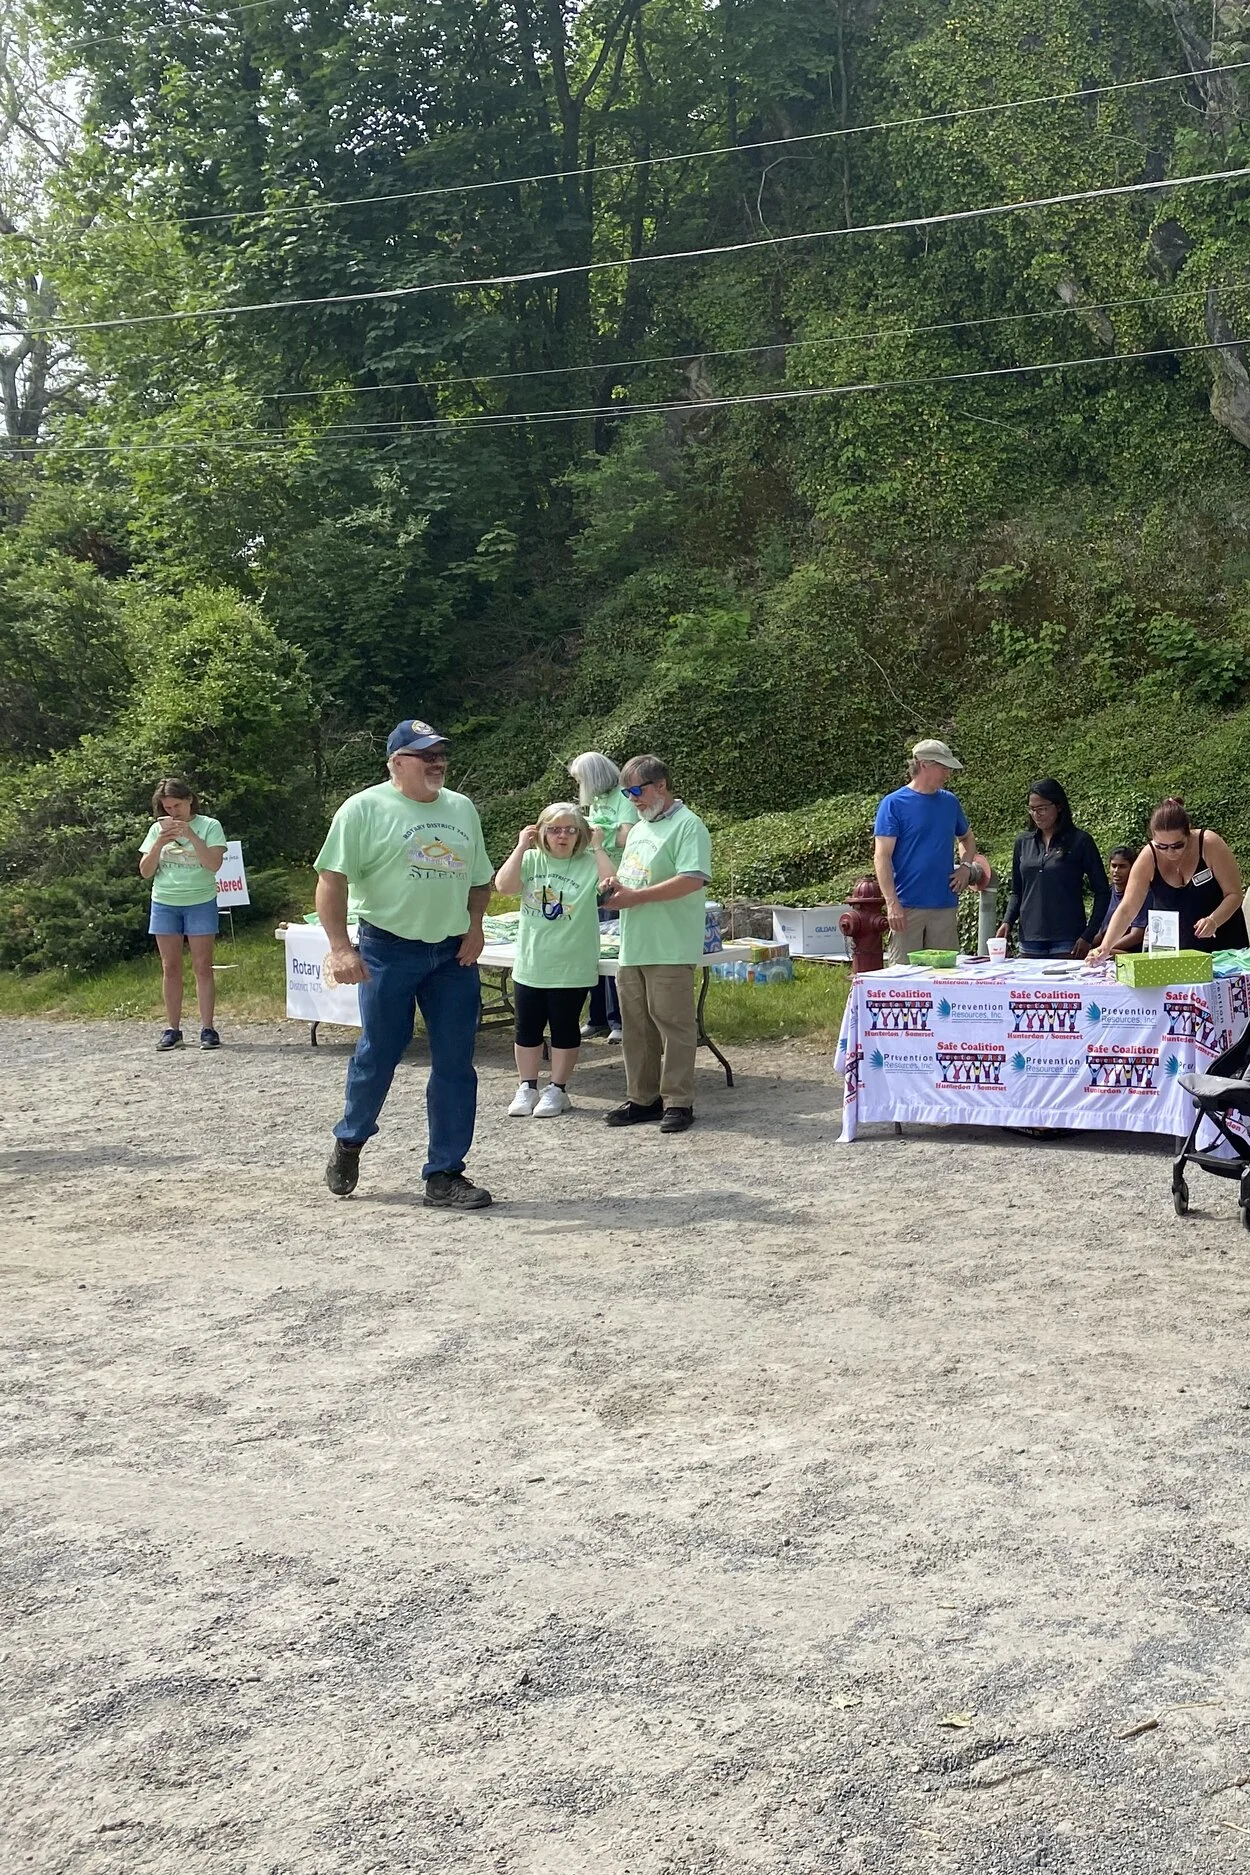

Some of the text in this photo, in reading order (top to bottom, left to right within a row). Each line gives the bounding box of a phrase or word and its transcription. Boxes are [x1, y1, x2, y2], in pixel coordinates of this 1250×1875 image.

[402, 824, 425, 840] ROTARY
[426, 823, 455, 831] DISTRICT
[292, 958, 321, 980] Rotary
[289, 980, 323, 994] District 7475
[867, 989, 932, 998] Safe Coalition
[1010, 990, 1080, 999] Safe Coalition
[1165, 991, 1188, 1000] Safe
[1101, 1007, 1157, 1015] Prevention
[1007, 1032, 1045, 1040] Hunterdon
[937, 1042, 1005, 1051] Safe Coalition
[1087, 1045, 1159, 1054] Safe Coalition
[883, 1054, 933, 1062] Prevention
[1026, 1057, 1080, 1065] Prevention
[1084, 1086, 1122, 1094] Hunterdon
[1128, 1088, 1160, 1096] Somerset
